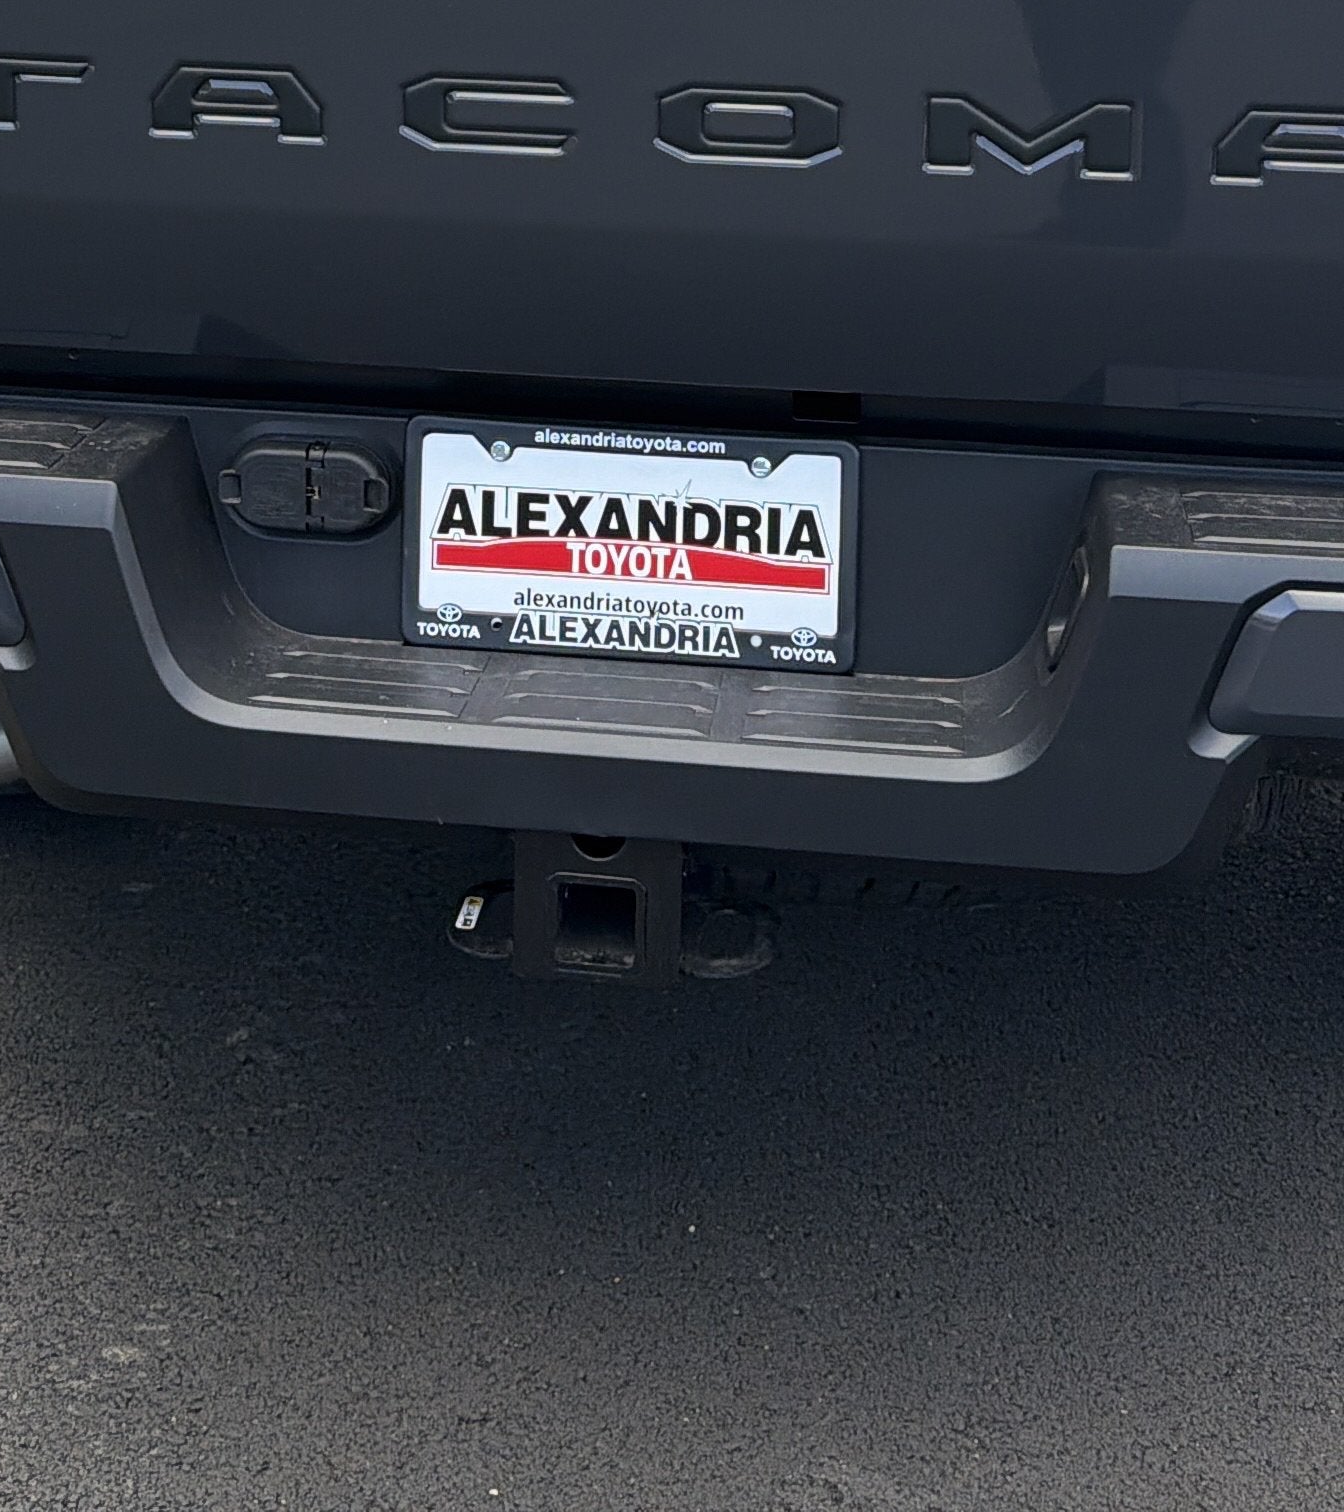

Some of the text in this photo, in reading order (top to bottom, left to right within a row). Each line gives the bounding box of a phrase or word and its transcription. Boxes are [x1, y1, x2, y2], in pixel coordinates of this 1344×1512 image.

[534, 428, 727, 455] alexandriatoyota.com
[436, 485, 827, 559] ALEXANDRIA
[565, 541, 694, 581] TOYOTA
[513, 588, 745, 620] alexandriatoyota.com
[416, 621, 482, 640] TOYOTA
[509, 610, 741, 658] ALEXANDRIA
[770, 645, 837, 665] TOYOTA
